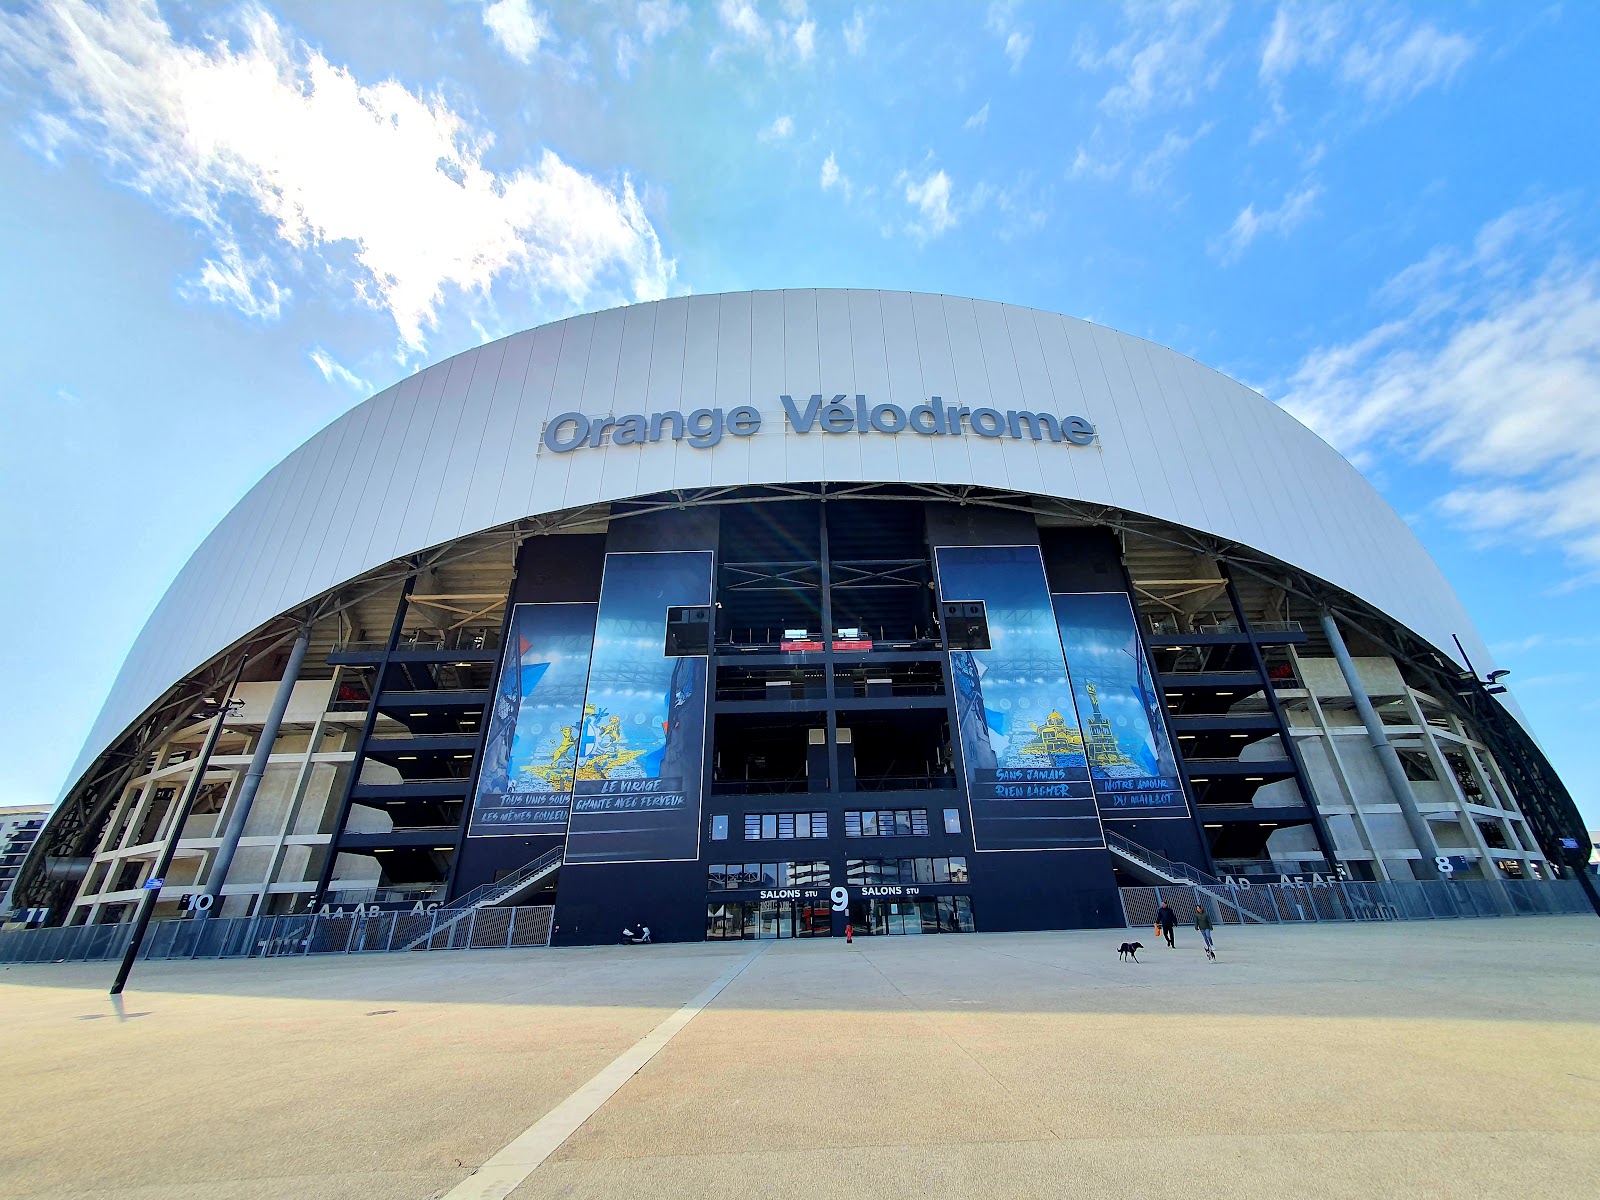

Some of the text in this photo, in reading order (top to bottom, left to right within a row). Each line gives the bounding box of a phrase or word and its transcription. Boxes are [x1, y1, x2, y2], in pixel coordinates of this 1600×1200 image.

[544, 394, 1094, 453] Orange Vélodrome
[996, 769, 1066, 781] SANS JAMAIS
[600, 780, 663, 794] LE VIRAGE
[995, 785, 1023, 797] RIEN
[1104, 779, 1169, 792] NOTRE AMOUR
[500, 794, 571, 806] TOUS UNIS SOUS
[575, 795, 686, 811] CHANTE AVEC FERVEUR
[1113, 792, 1174, 806] DU MAILLOT
[480, 812, 499, 822] LES
[533, 810, 569, 821] COULEU
[1435, 856, 1454, 872] 8
[760, 889, 818, 899] SALONS STU
[861, 886, 920, 896] SALONS STU
[187, 894, 214, 910] 10
[830, 886, 849, 912] 9
[25, 907, 50, 923] 11
